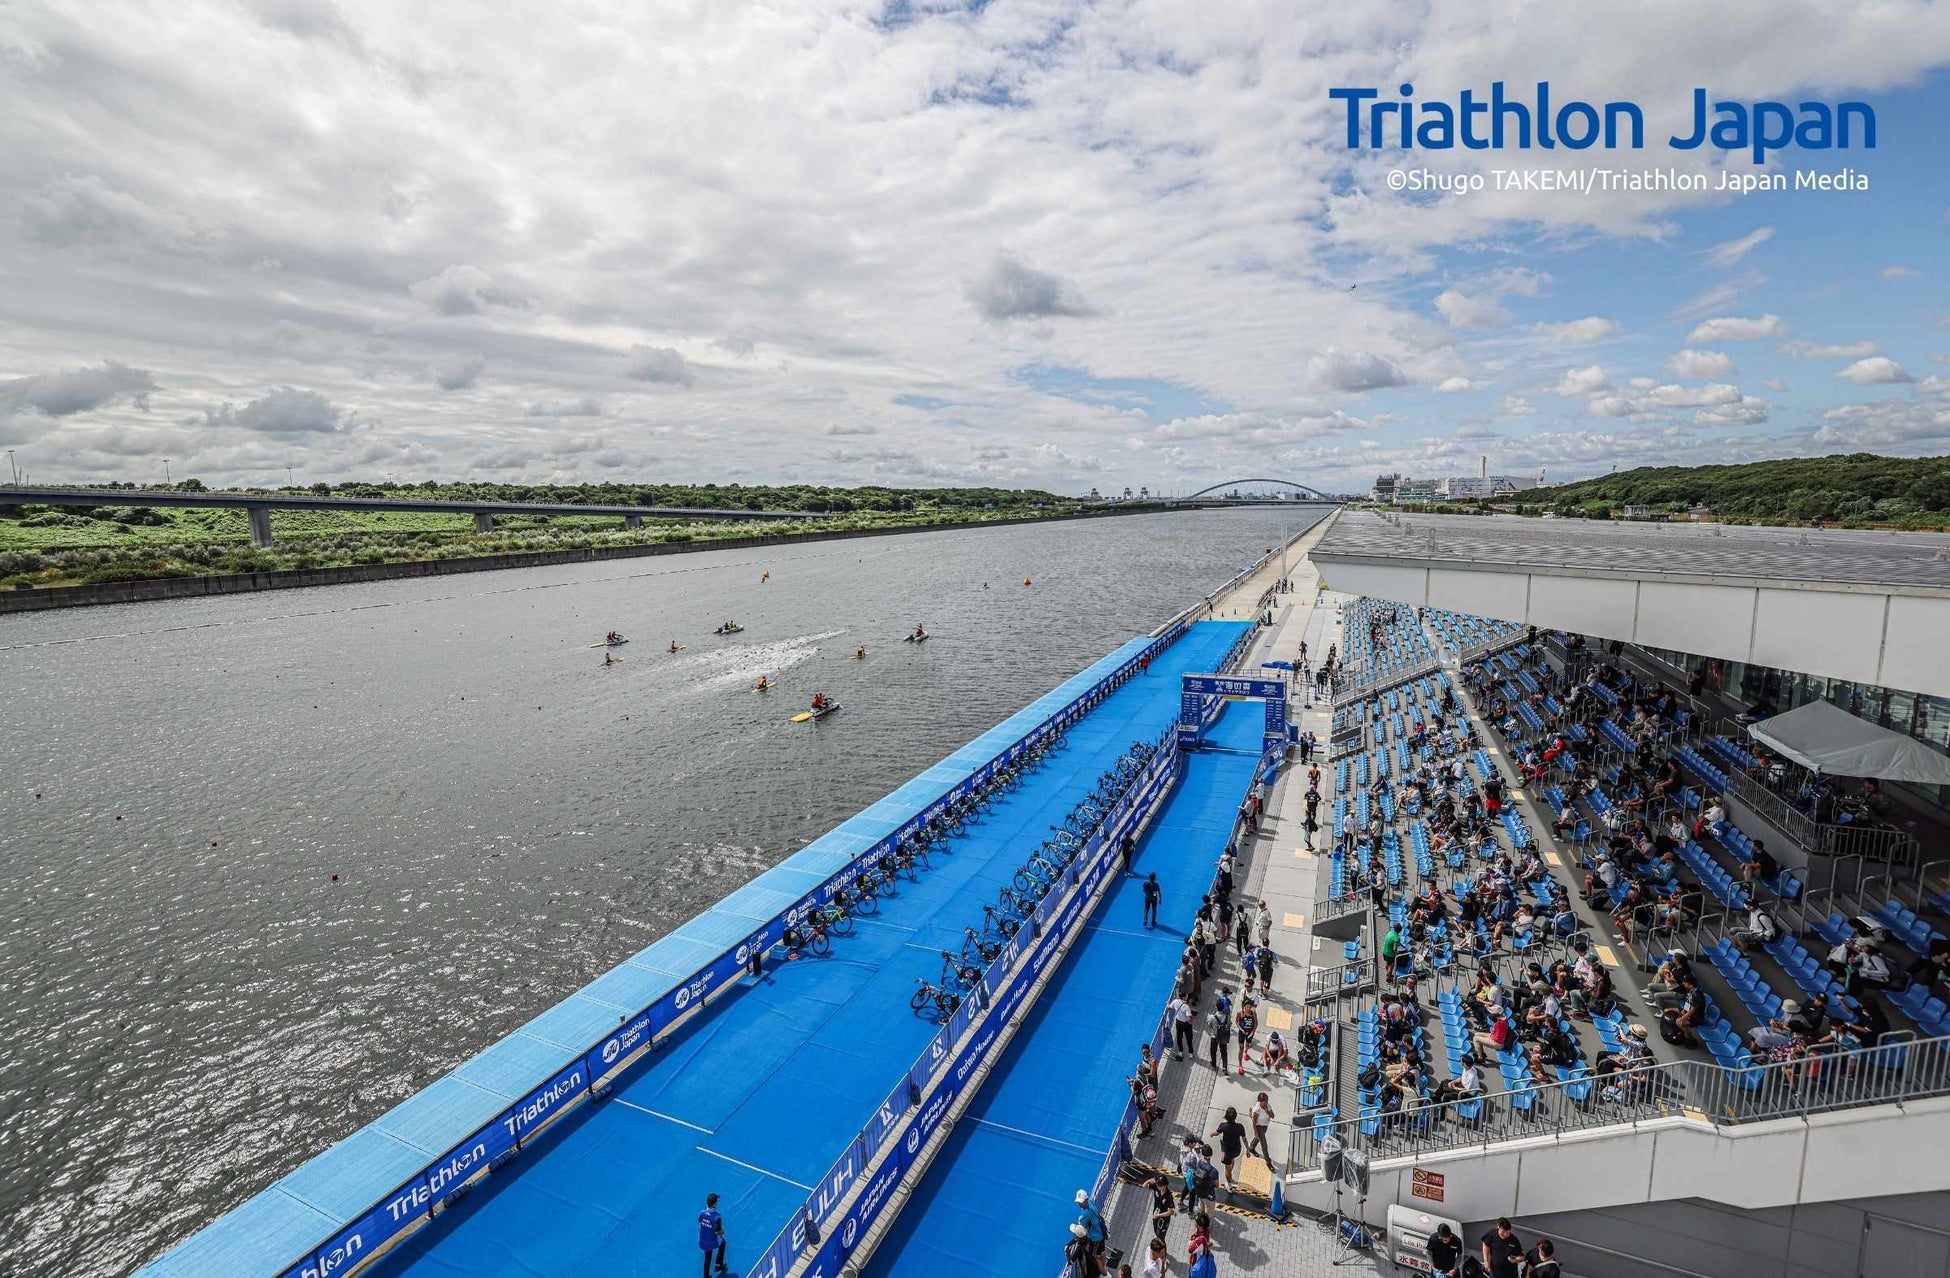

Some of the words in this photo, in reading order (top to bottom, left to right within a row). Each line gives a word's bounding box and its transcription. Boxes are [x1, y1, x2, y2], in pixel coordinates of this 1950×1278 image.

[620, 1018, 650, 1042] Triathlon
[620, 1032, 641, 1052] Japan
[957, 1052, 977, 1080] Daiwa
[974, 1030, 995, 1053] House
[504, 1070, 580, 1136] Triathlon
[920, 1095, 943, 1128] JAPAN
[924, 1090, 953, 1135] AIRLINES
[386, 1142, 485, 1222] Triathlon
[858, 1173, 886, 1217] JAPAN
[861, 1166, 898, 1224] AIRLINES
